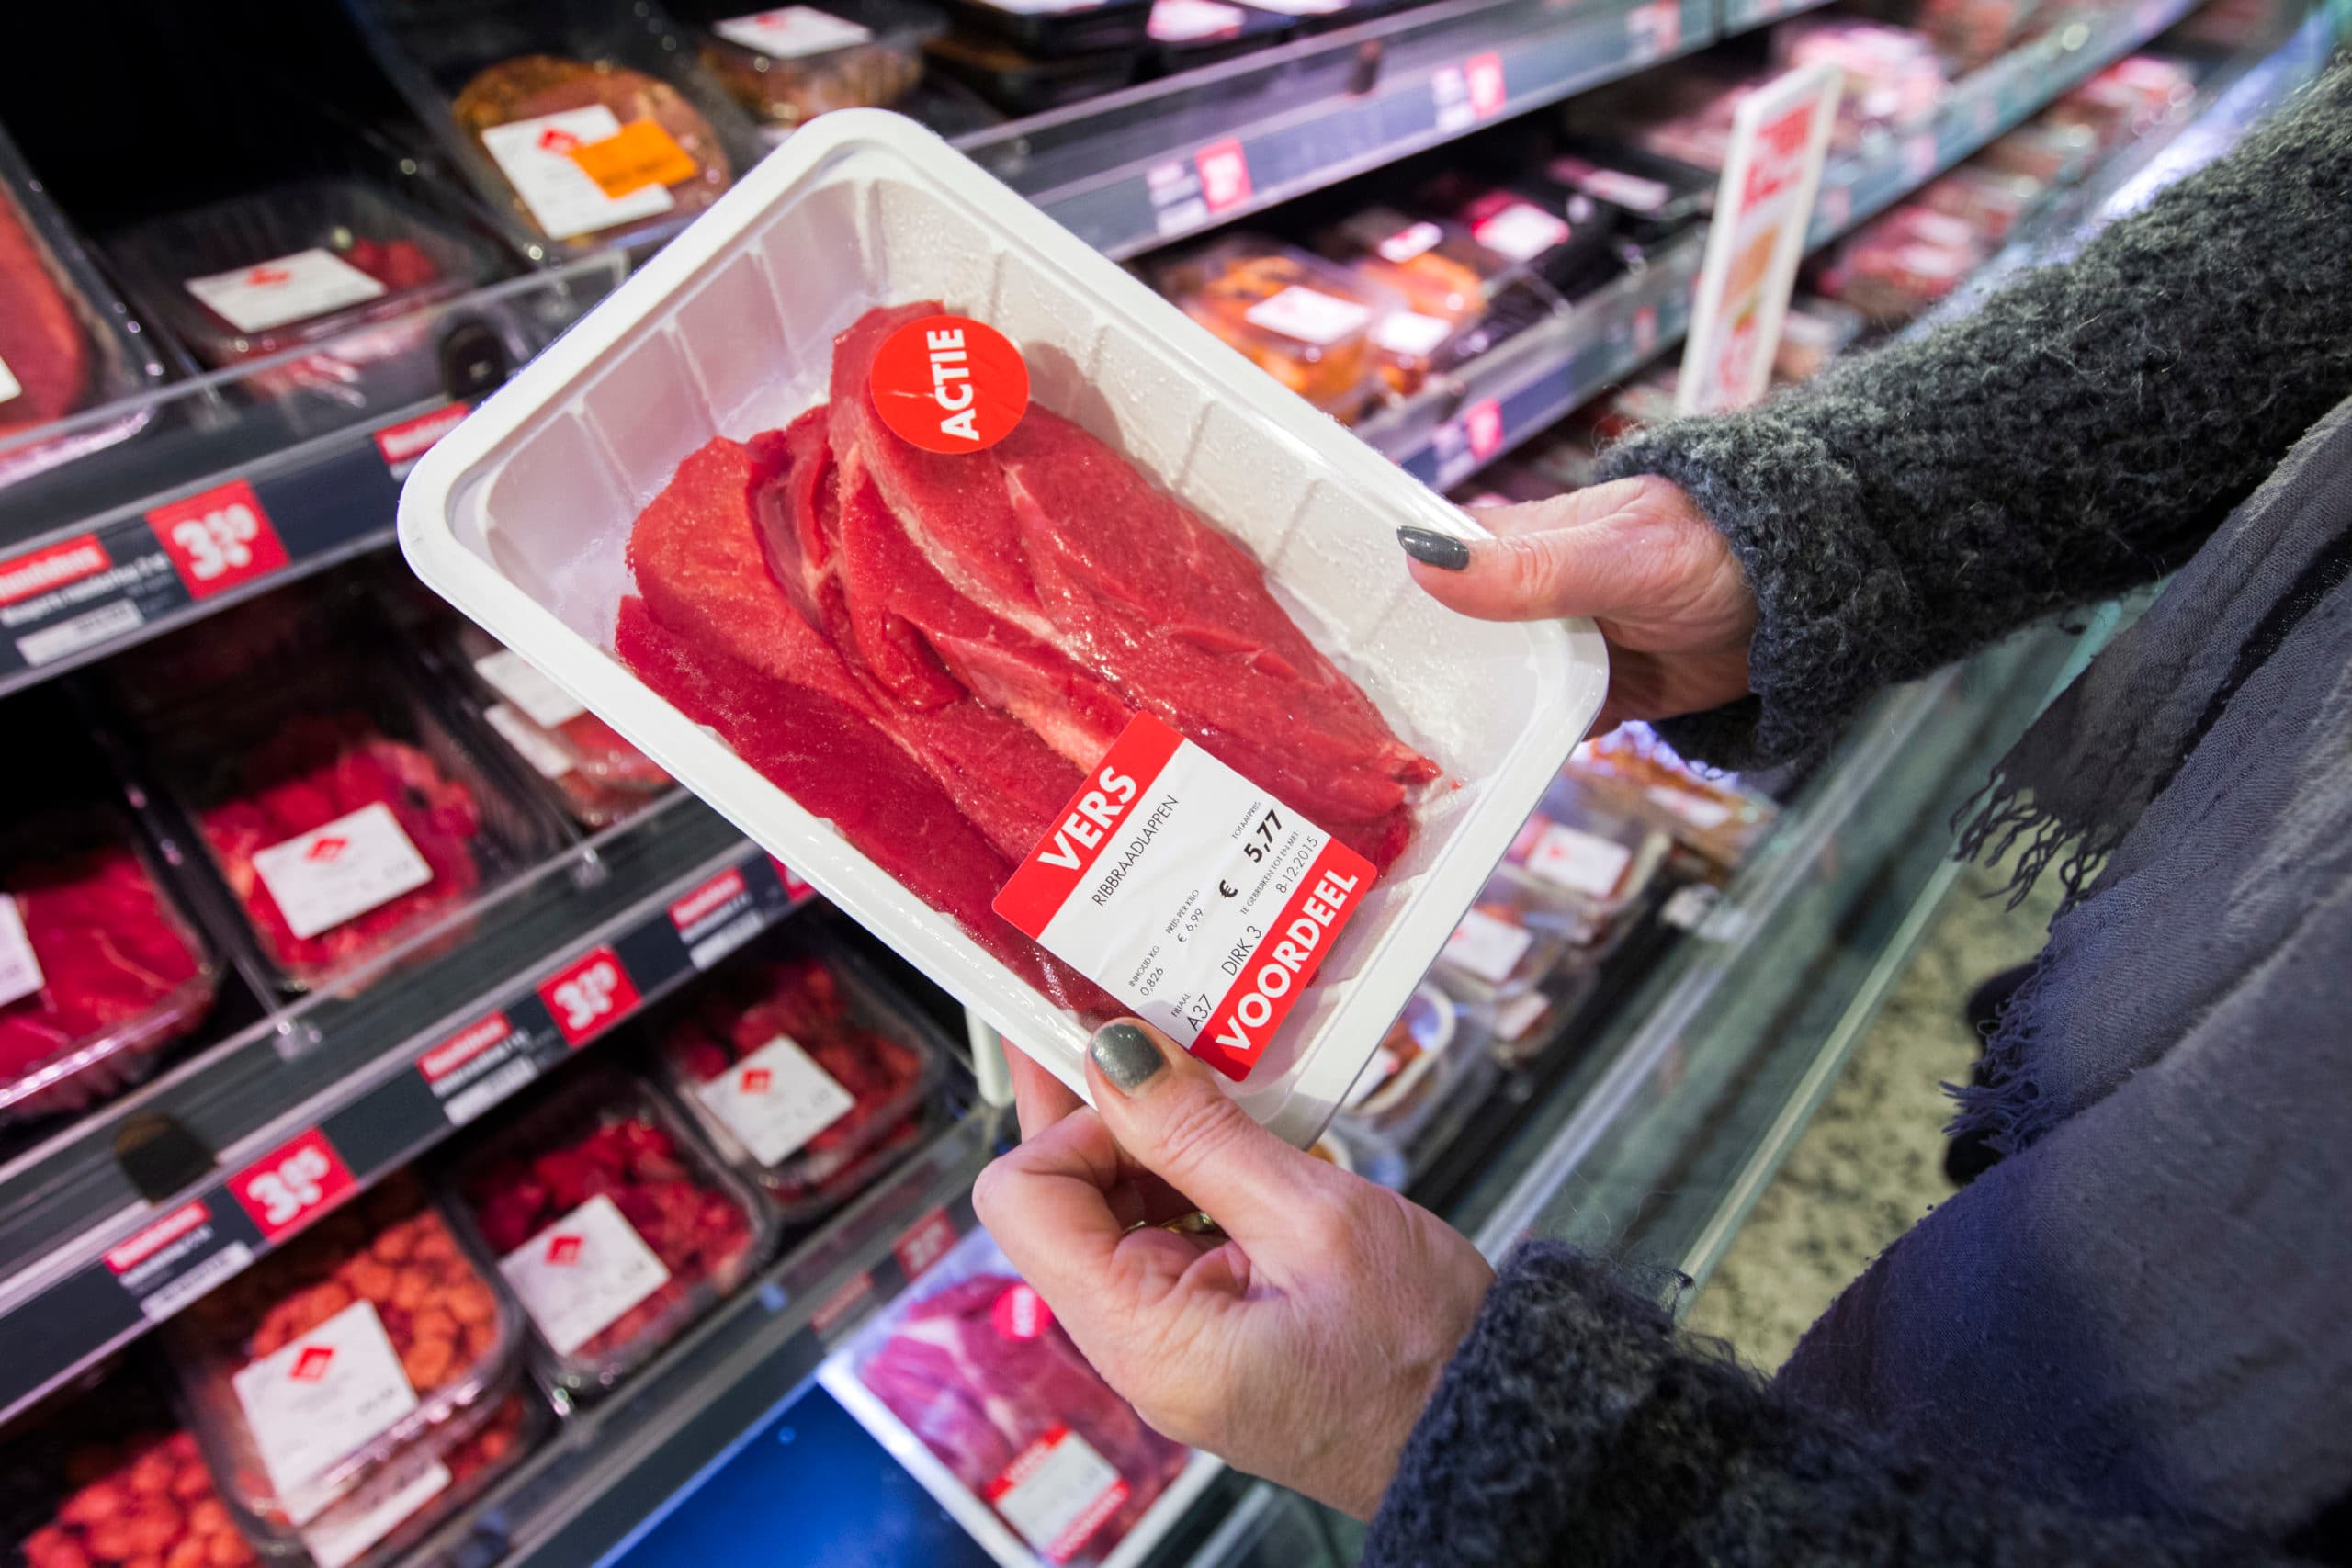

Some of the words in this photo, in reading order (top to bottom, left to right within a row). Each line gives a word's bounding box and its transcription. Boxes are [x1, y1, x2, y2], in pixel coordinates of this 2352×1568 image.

[926, 328, 980, 441] ACTIE
[1036, 766, 1136, 871] VERS
[1243, 808, 1283, 863] 5,77
[1091, 795, 1179, 908] RIBBRAADLAPPEN
[1275, 835, 1318, 894] 8-12-2015
[1176, 905, 1189, 919] PER
[1184, 889, 1199, 907] KILO
[1239, 905, 1249, 915] TE
[1247, 870, 1274, 907] GEBRUIKEN
[1271, 855, 1283, 872] TOT
[1280, 844, 1290, 856] EN
[1185, 908, 1204, 932] 6,99
[1128, 958, 1152, 987] INHOUD
[1148, 945, 1160, 959] KG
[1216, 869, 1359, 1051] VOORDEEL
[1221, 938, 1254, 977] DIRK
[1246, 925, 1262, 939] 3
[1140, 966, 1164, 997] 0,826
[1170, 993, 1192, 1018] FILIAAL
[1187, 993, 1212, 1032] A37
